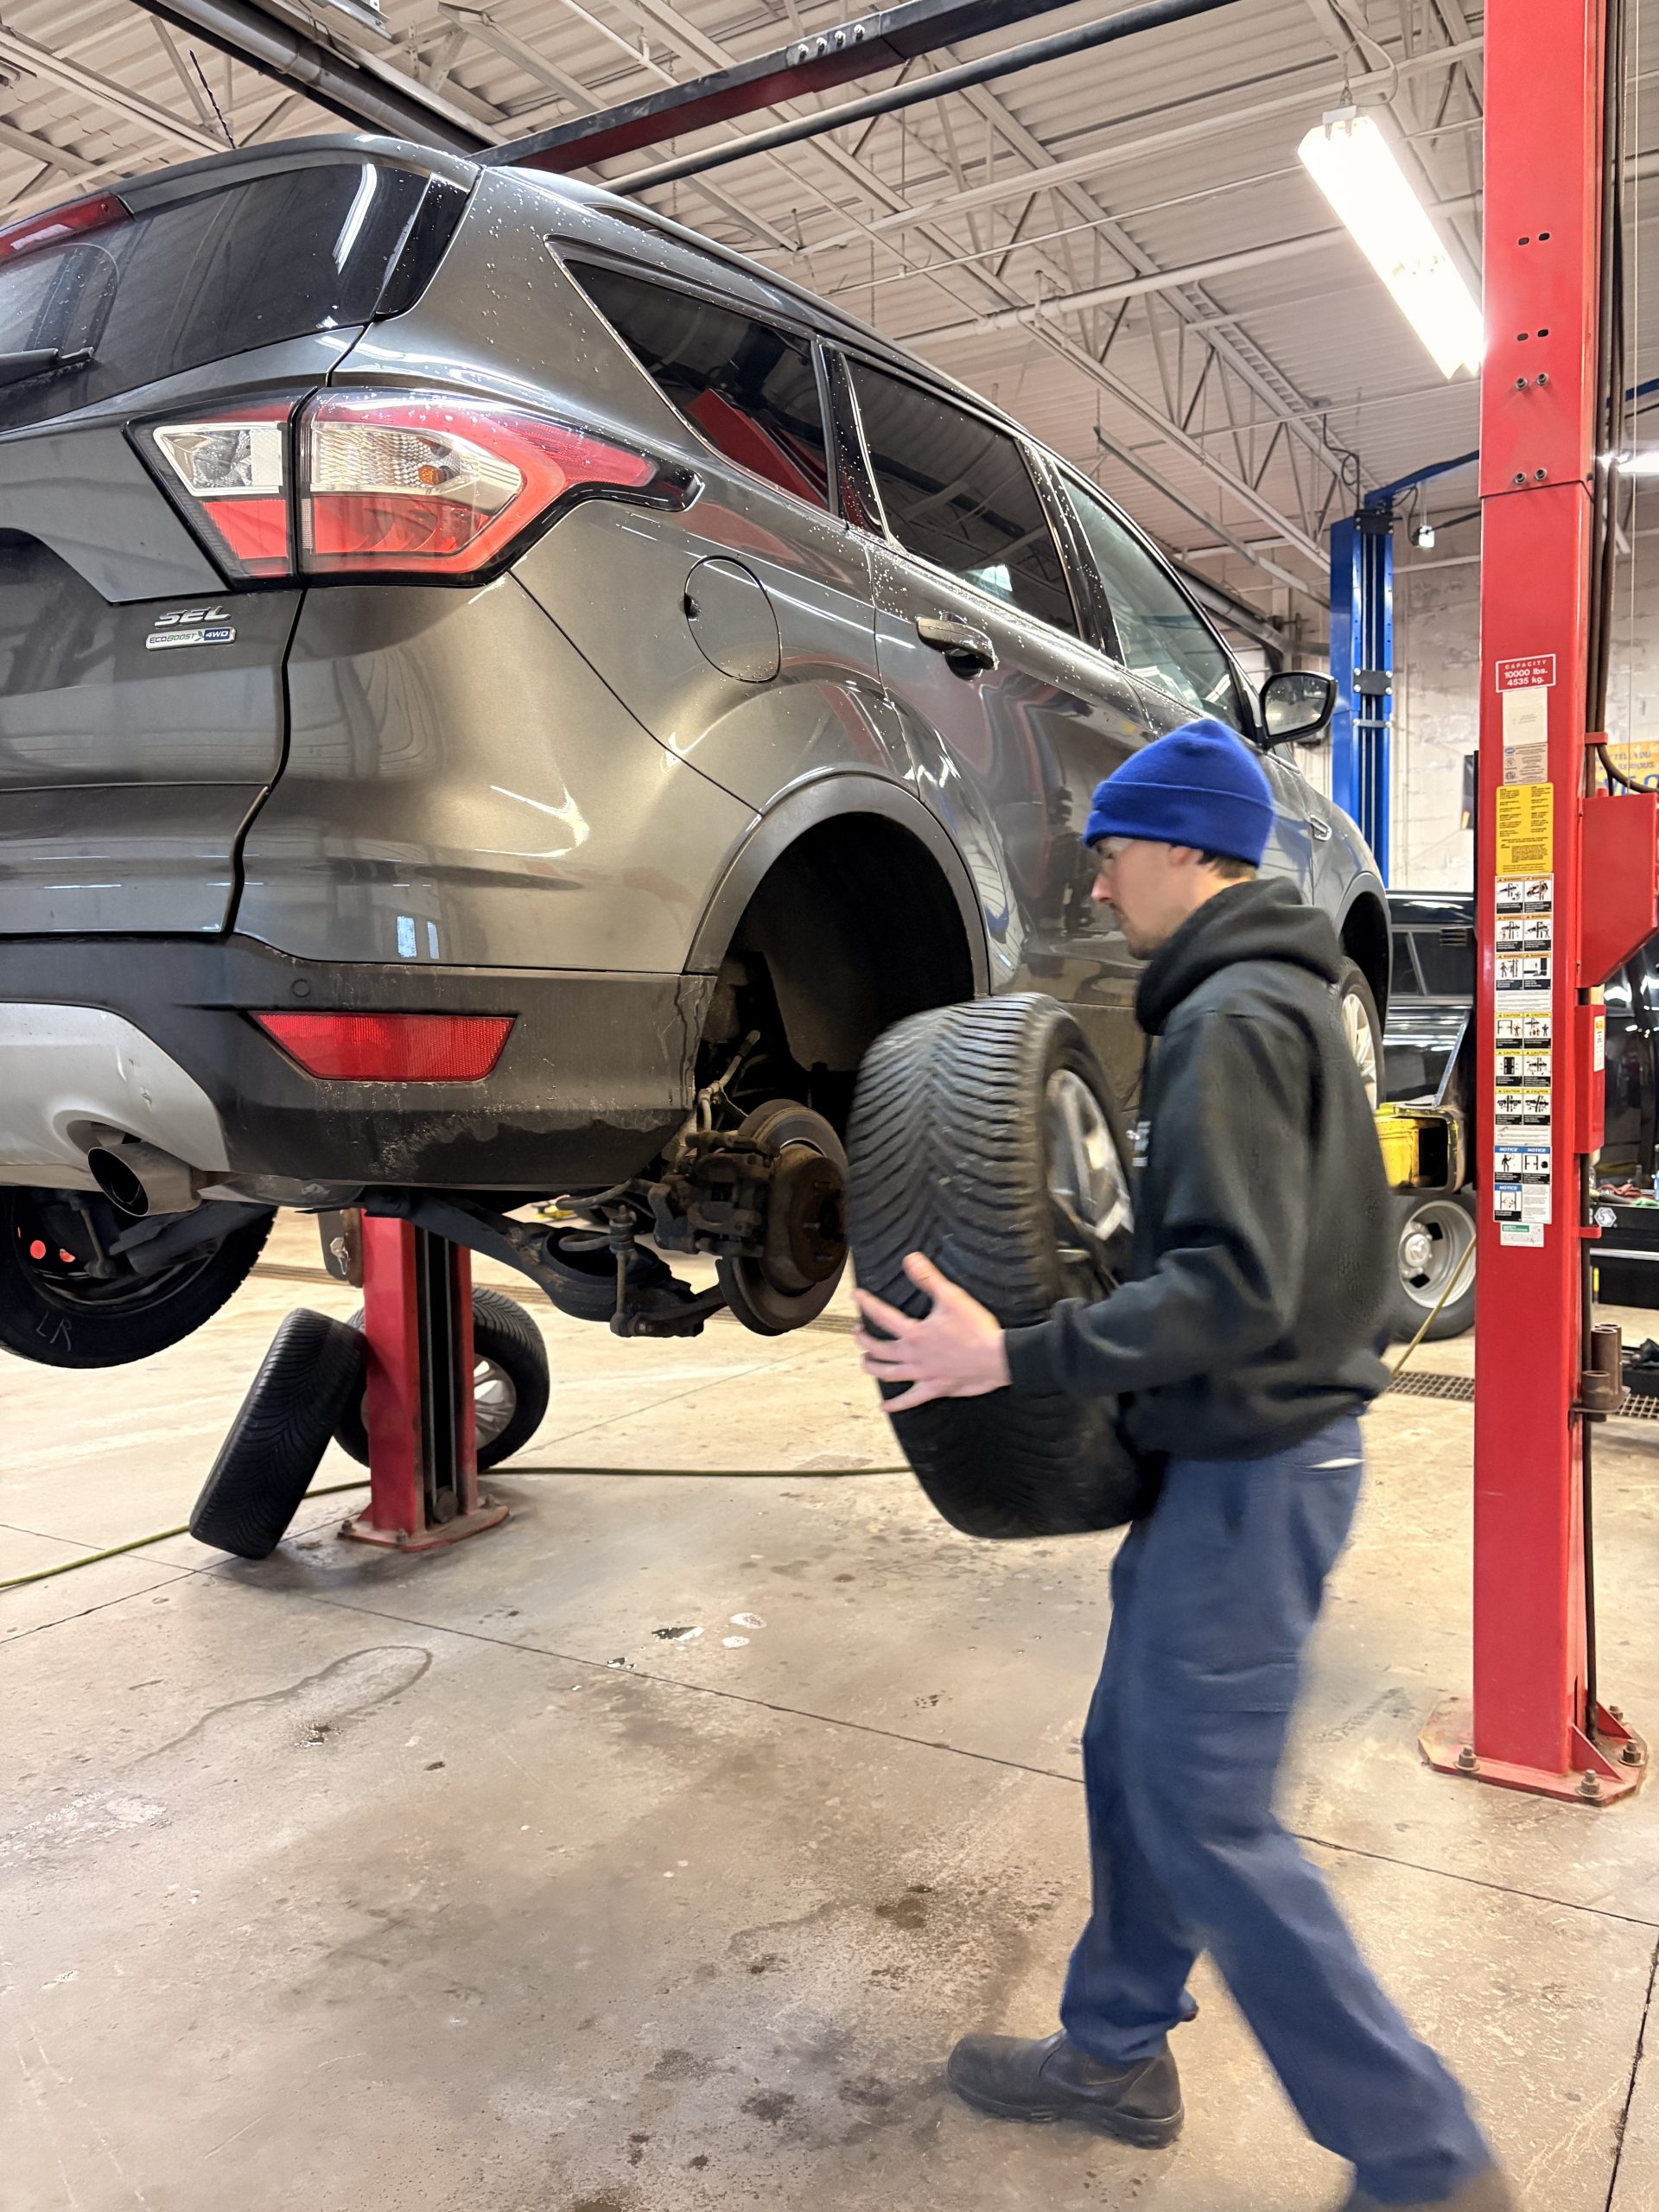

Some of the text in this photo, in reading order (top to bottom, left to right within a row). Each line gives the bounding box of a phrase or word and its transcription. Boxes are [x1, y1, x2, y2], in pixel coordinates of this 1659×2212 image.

[154, 606, 232, 628] SEL
[149, 632, 197, 644] ECOBOOST
[1504, 659, 1547, 671] CAPACITY
[1504, 669, 1530, 679] 10000
[1506, 677, 1529, 686] 4535
[35, 1312, 73, 1352] LR
